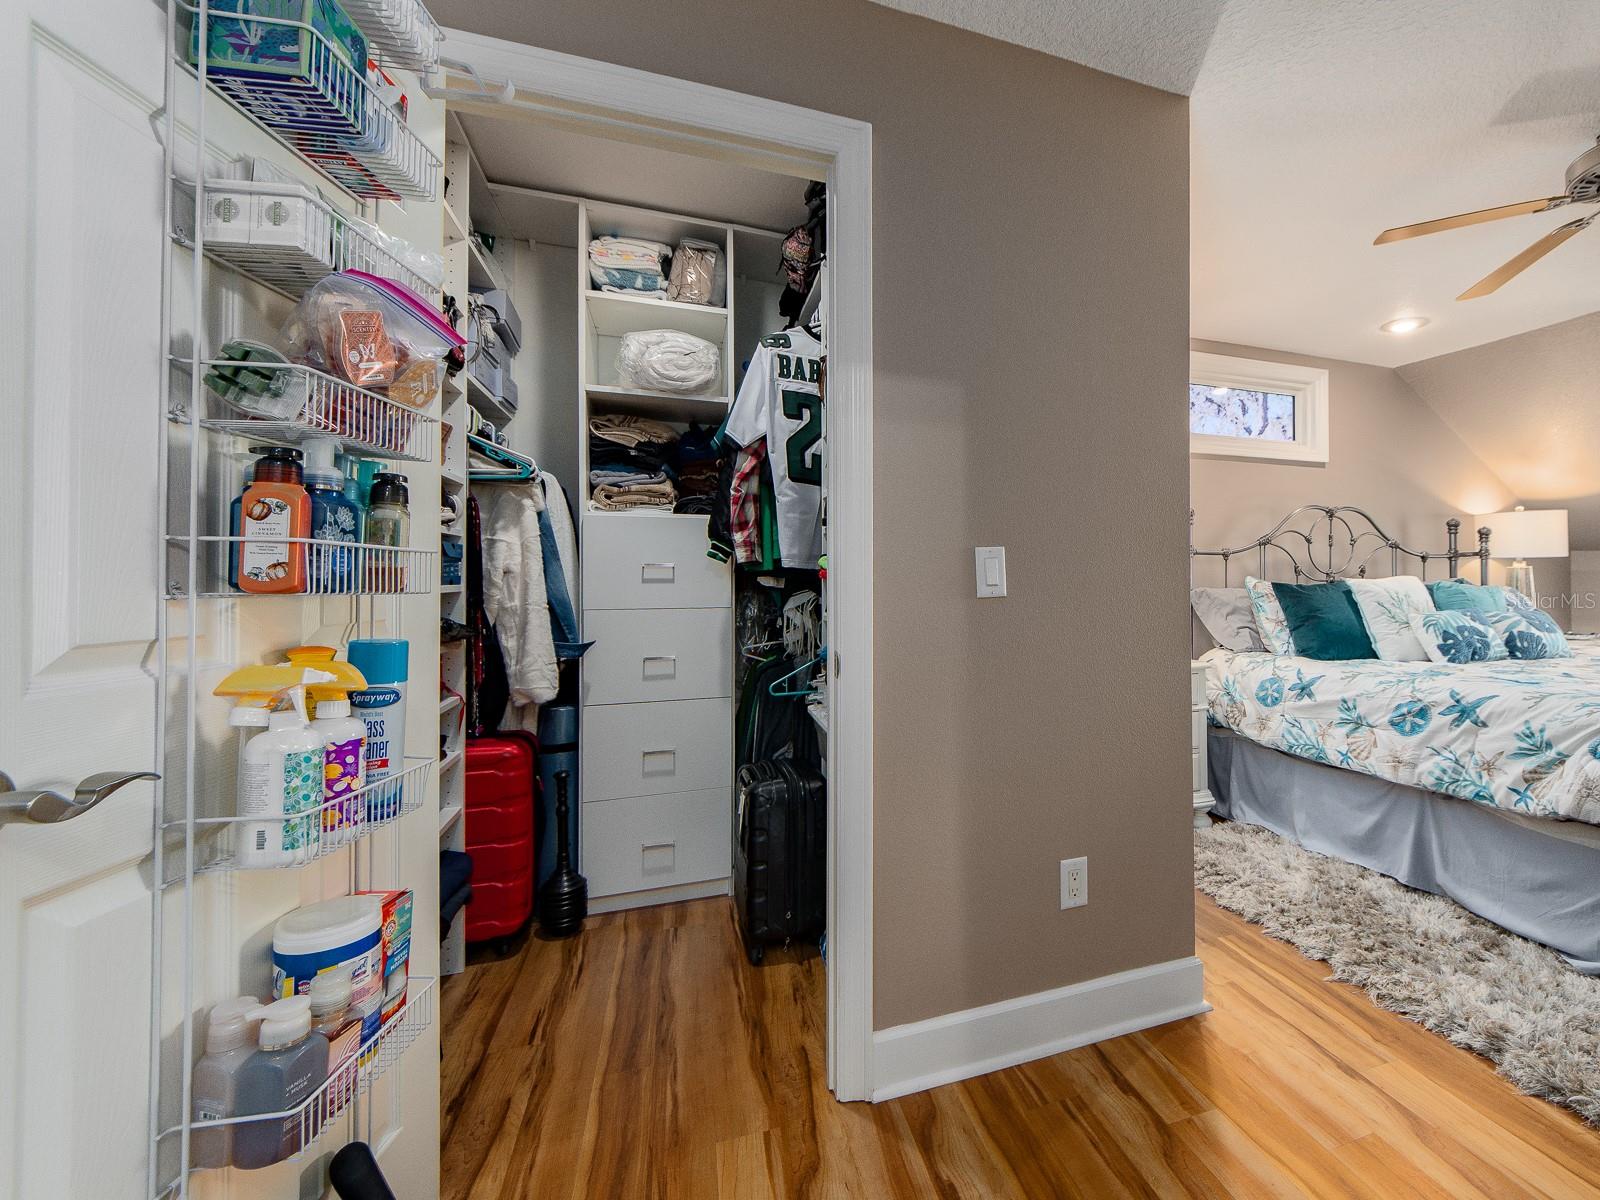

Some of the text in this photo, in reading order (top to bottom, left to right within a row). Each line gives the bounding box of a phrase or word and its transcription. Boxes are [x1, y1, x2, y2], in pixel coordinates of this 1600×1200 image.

[777, 353, 821, 383] BAR
[782, 390, 821, 486] 2
[352, 692, 395, 704] Sprayway
[364, 718, 385, 738] ass
[366, 741, 389, 760] aner
